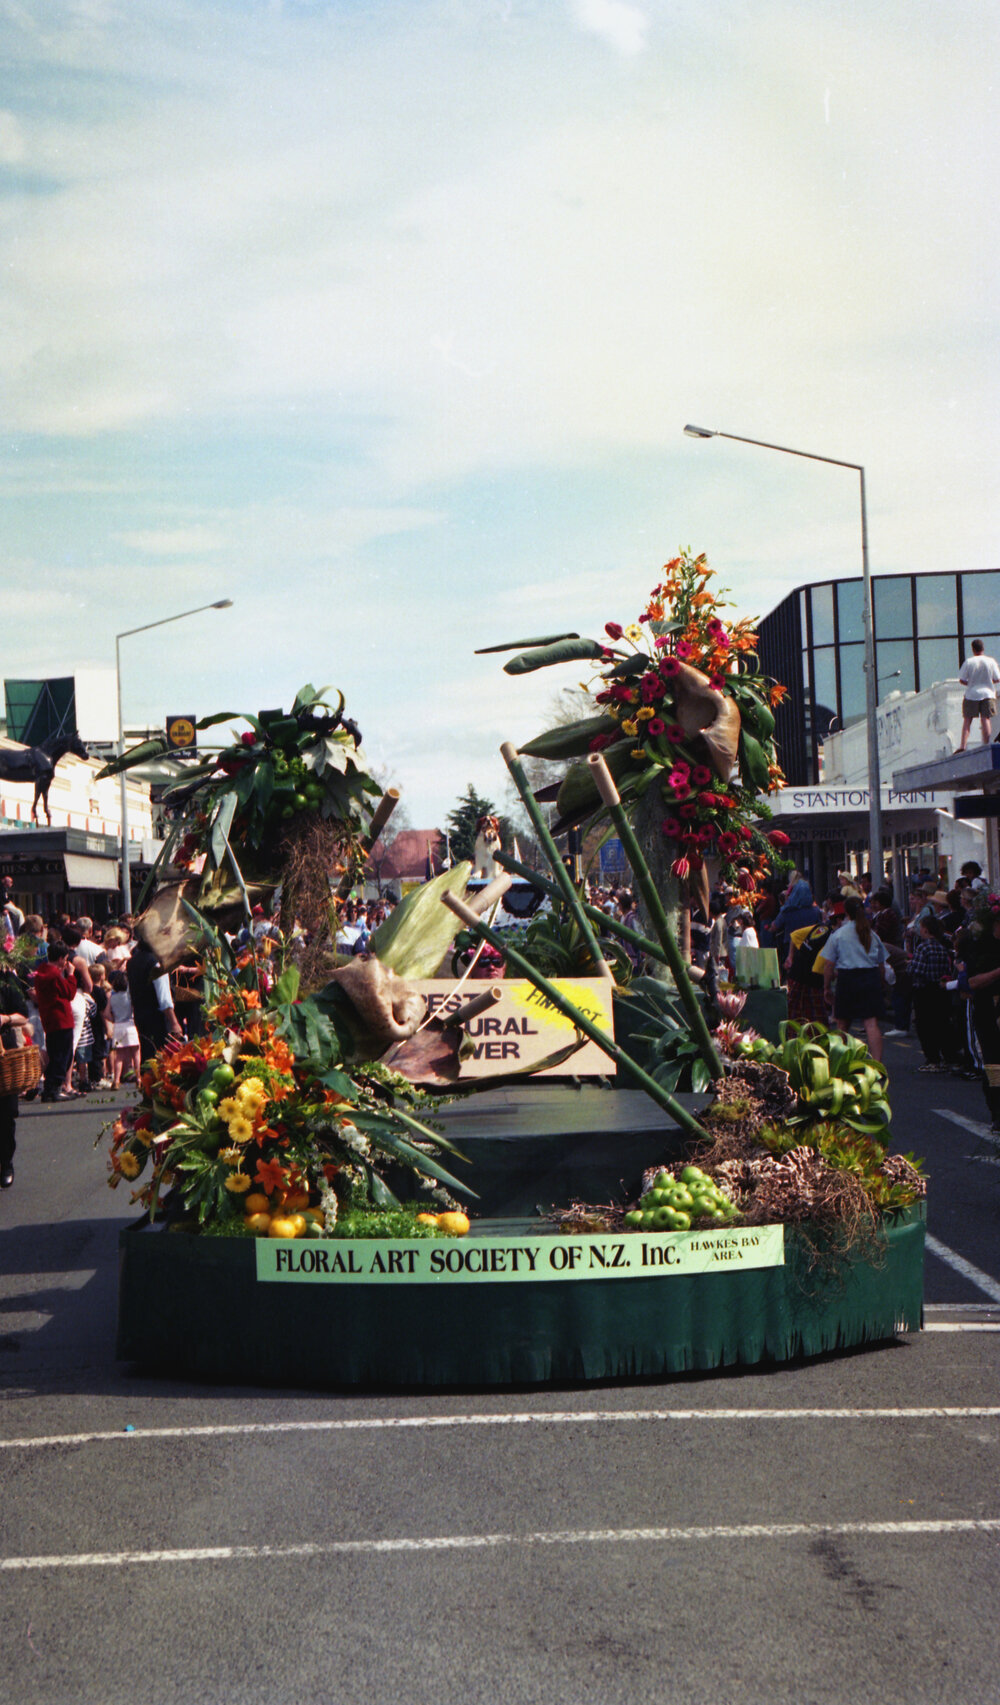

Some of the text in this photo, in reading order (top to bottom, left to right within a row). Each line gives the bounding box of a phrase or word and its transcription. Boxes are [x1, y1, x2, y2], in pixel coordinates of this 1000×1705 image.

[793, 790, 935, 808] STANTON PRINT
[787, 830, 808, 840] ON
[421, 993, 481, 1013] EST
[465, 1017, 538, 1037] URAL
[690, 1236, 760, 1251] HAWKES BAY
[276, 1242, 681, 1273] FLORAL ART SOCIETY OF N.Z. Inc.
[712, 1250, 743, 1261] AREA
